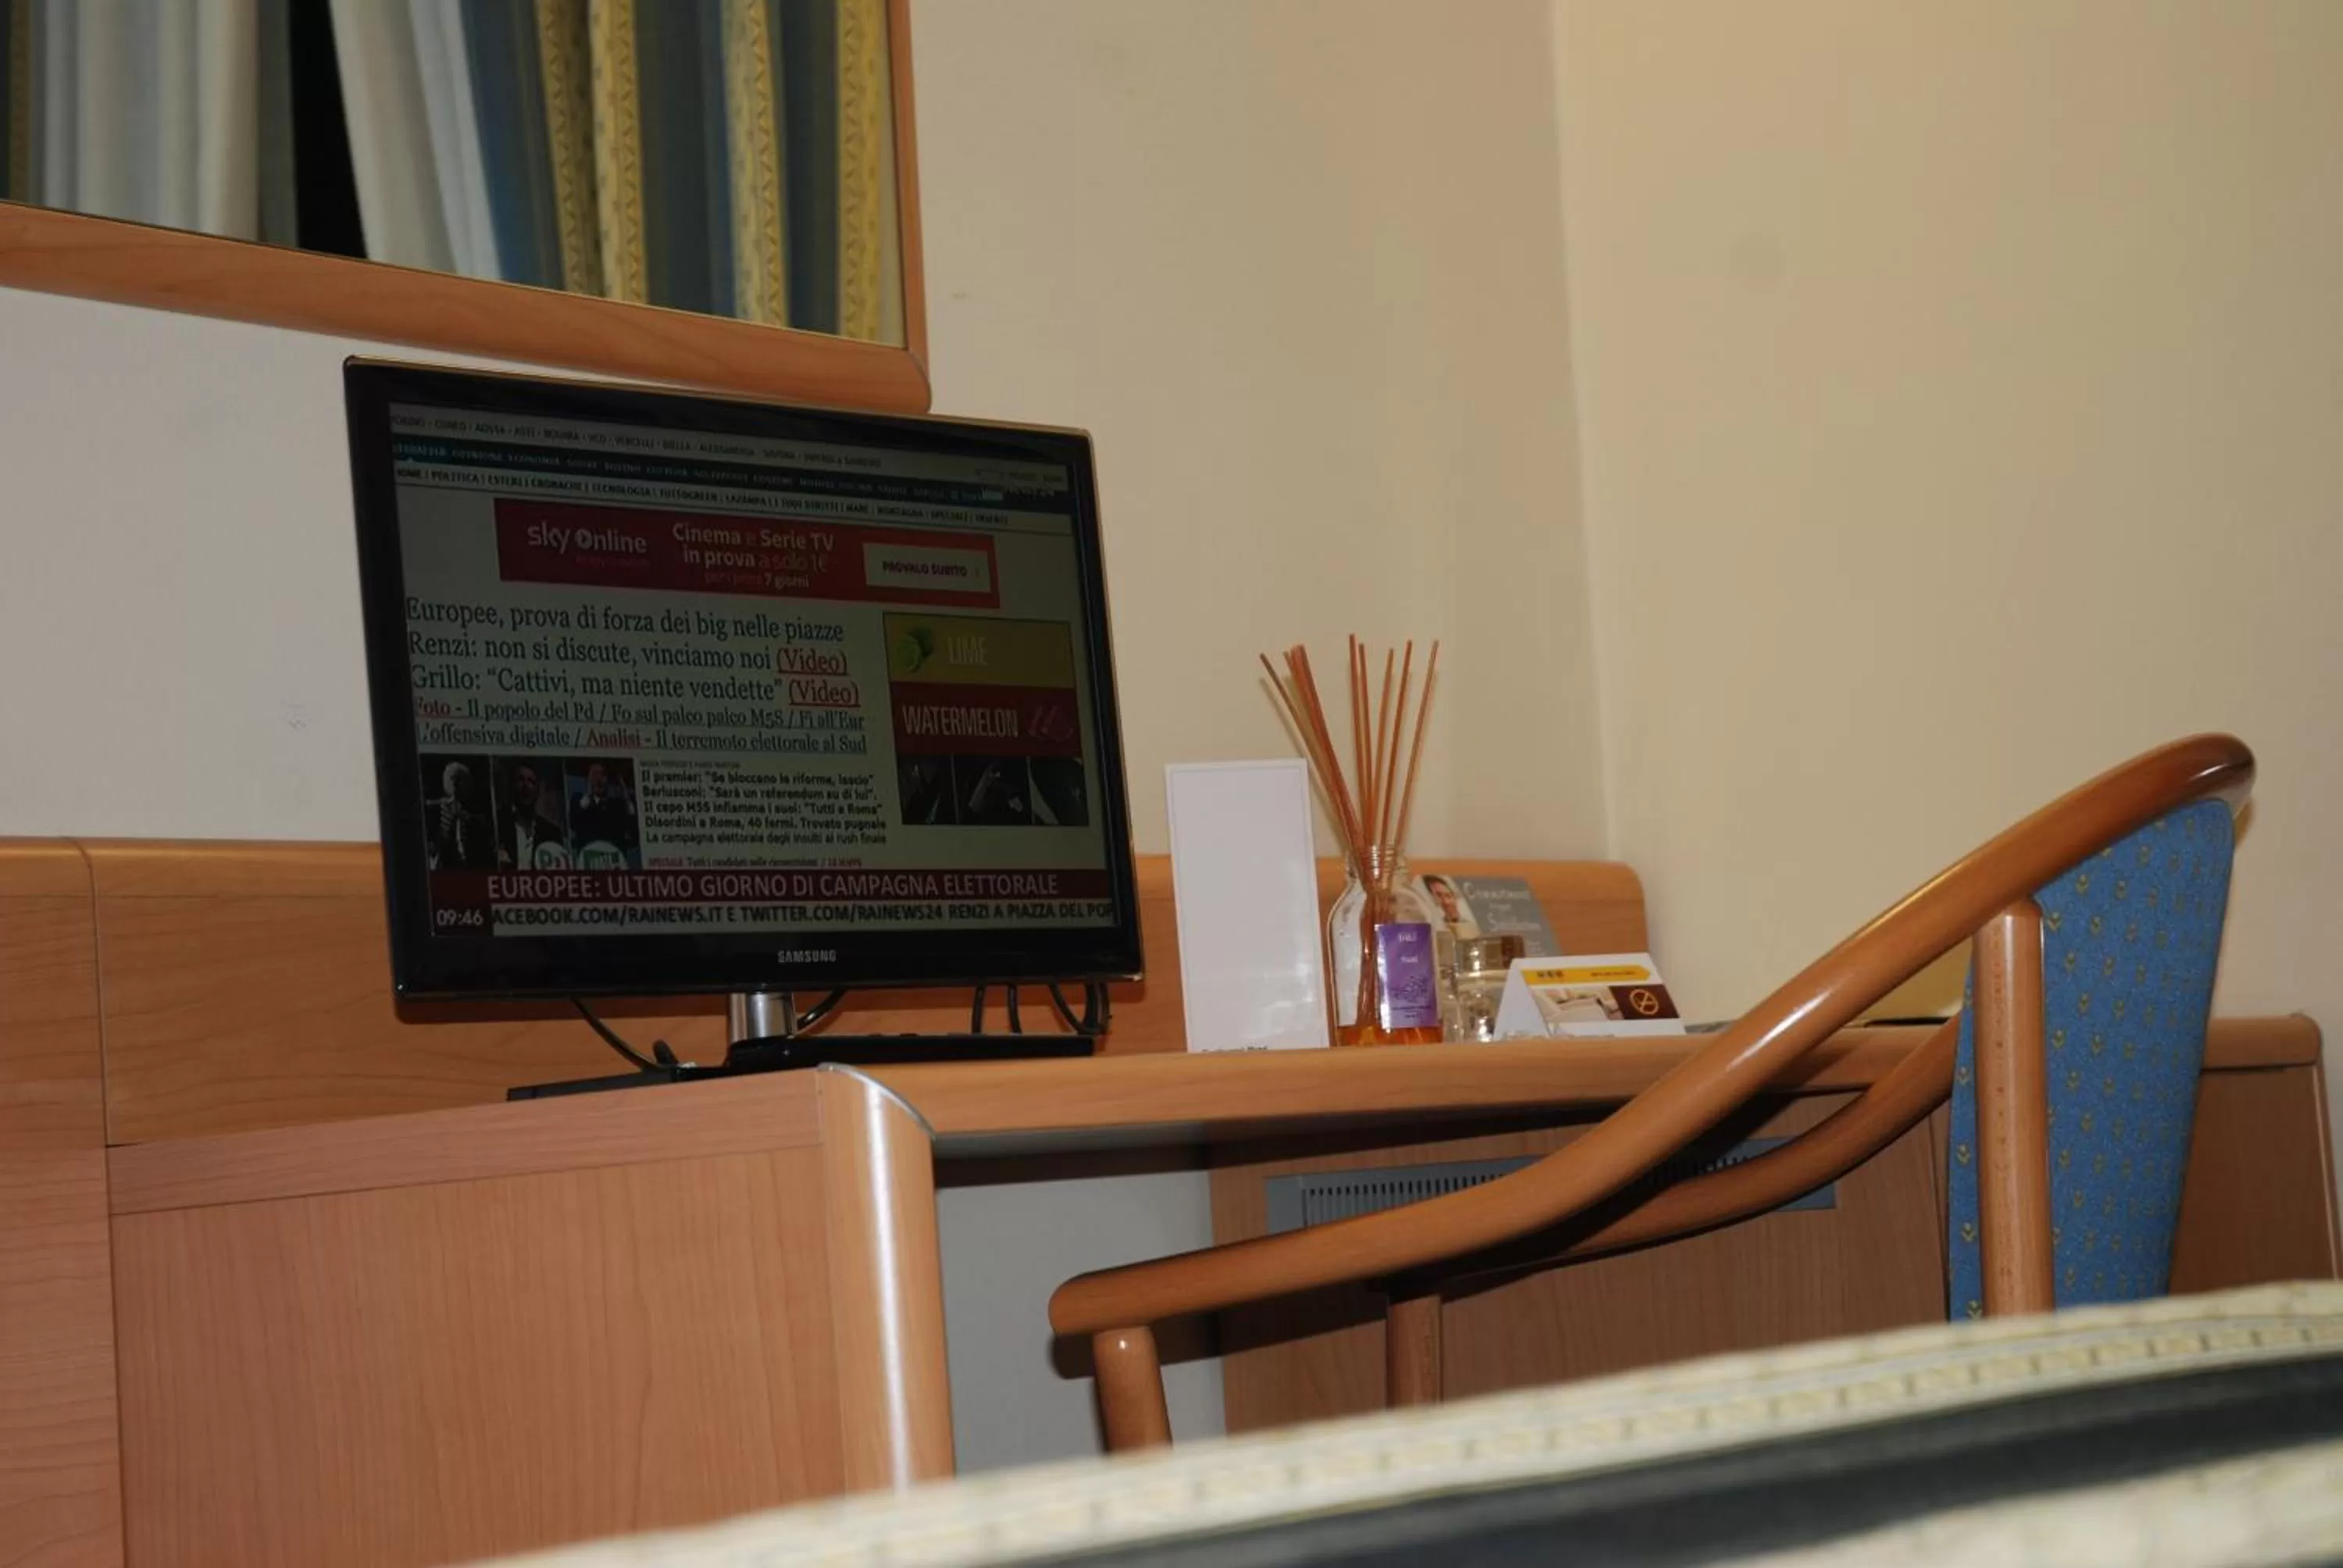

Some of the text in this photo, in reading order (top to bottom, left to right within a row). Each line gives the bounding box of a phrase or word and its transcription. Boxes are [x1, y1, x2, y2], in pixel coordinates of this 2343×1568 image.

[527, 519, 570, 554] sky
[672, 521, 741, 545] Cinema
[759, 528, 806, 550] Serie
[810, 531, 835, 551] TV
[683, 544, 700, 563] in
[704, 547, 755, 568] prova
[406, 597, 843, 643] Europee, prova di forza dei big nelle piazze
[410, 631, 848, 675] Renzi: non si discute, vinciamo noi (Video)
[947, 636, 988, 665] LIME
[412, 664, 480, 690] Grillo:
[581, 675, 614, 695] ma
[621, 672, 683, 697] niente
[789, 678, 860, 705] (Video)
[468, 699, 480, 717] Il
[484, 700, 540, 722] popolo
[544, 701, 569, 721] del
[637, 704, 658, 725] sul
[662, 705, 703, 728] palco
[707, 706, 747, 729] palco
[902, 704, 1018, 737] WATERMELON
[509, 725, 570, 748] digitale
[587, 728, 641, 749] Analisi
[672, 732, 747, 751] terremoto
[751, 732, 818, 752] elettorale
[840, 734, 866, 754] Sud
[487, 873, 1059, 898] EUROPEE: ULTIMO GIORNO DI CAMPAGNA ELETTORALE
[436, 908, 484, 926] 09:46
[727, 904, 735, 921] E
[948, 902, 990, 920] RENZI
[993, 903, 1004, 919] A
[1007, 902, 1055, 919] PIAZZA
[1060, 902, 1084, 919] DEL
[777, 950, 837, 963] SAMSUNG
